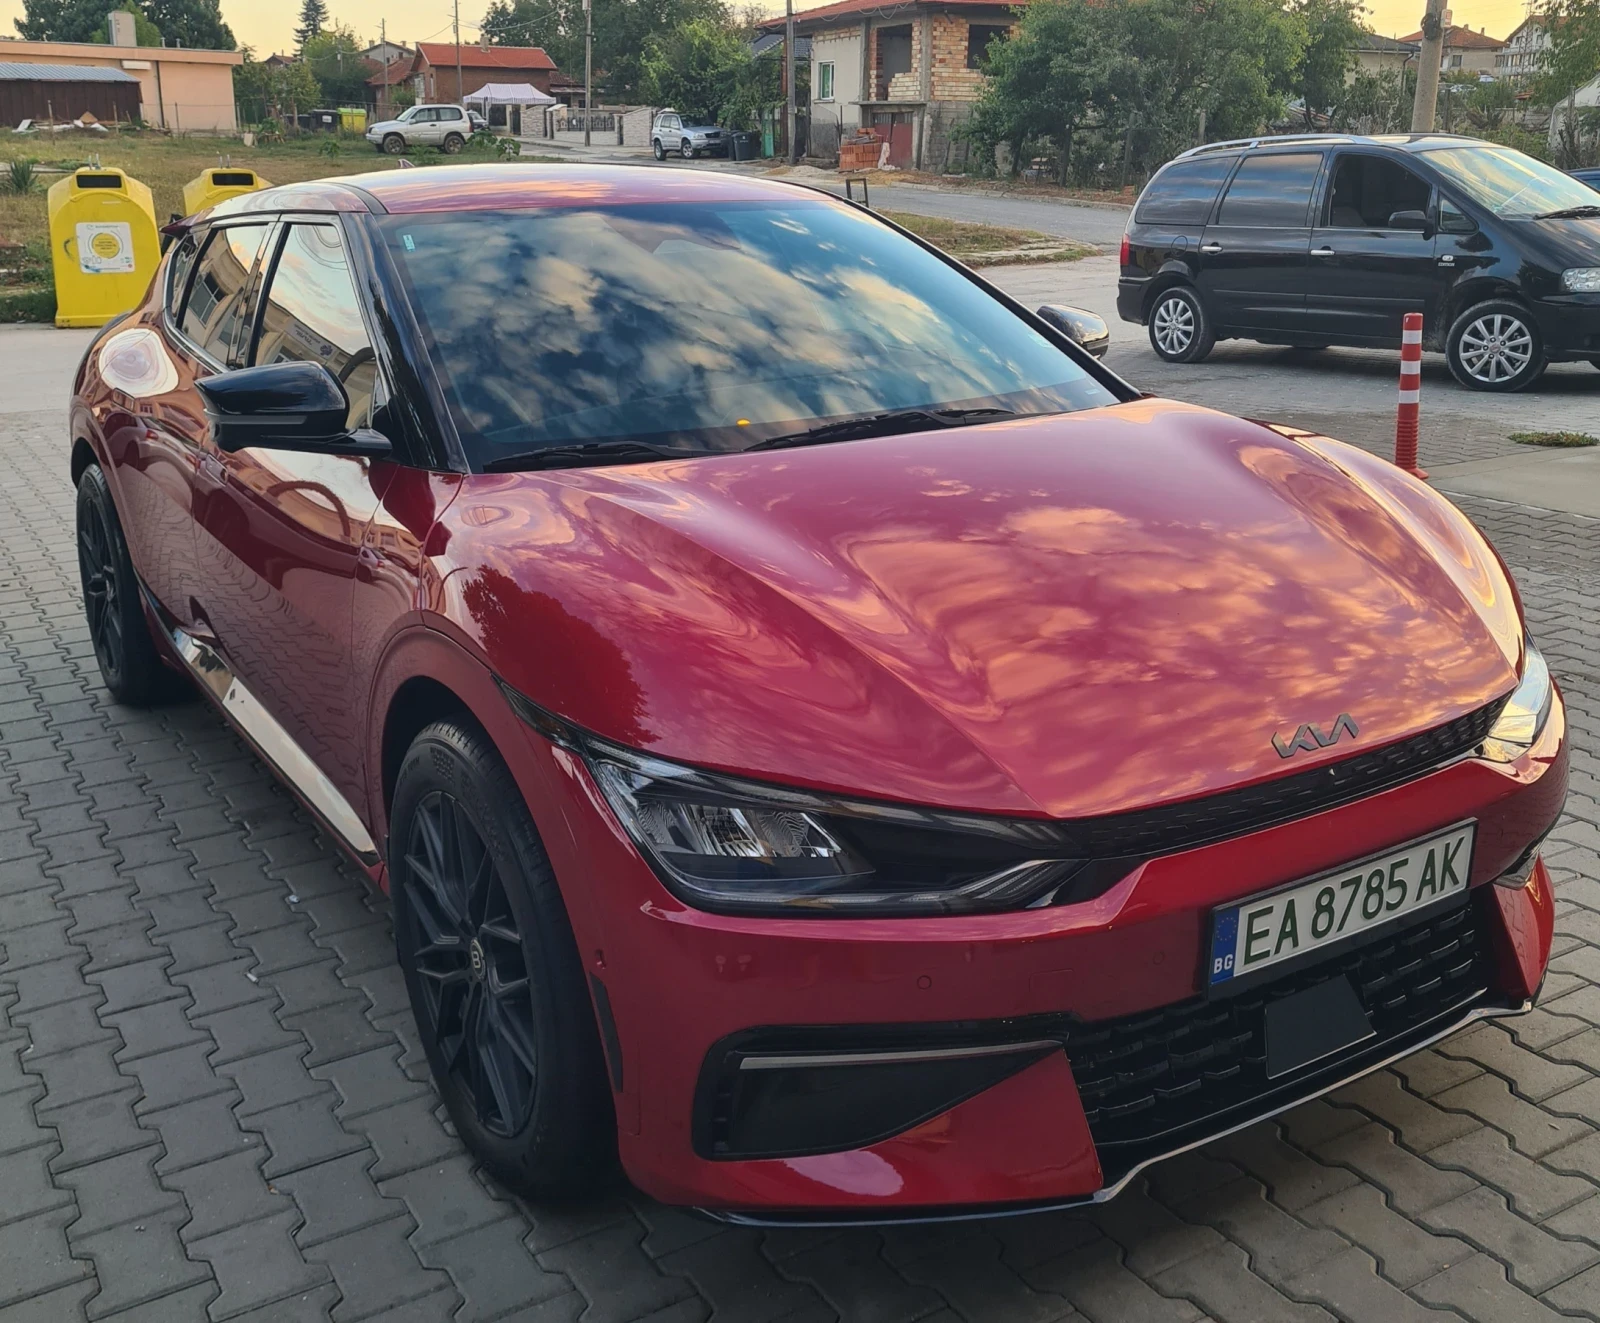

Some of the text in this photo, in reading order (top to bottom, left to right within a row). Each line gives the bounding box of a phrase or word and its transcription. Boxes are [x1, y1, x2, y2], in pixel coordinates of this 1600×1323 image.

[1271, 712, 1360, 759] KIA
[1243, 836, 1465, 966] EA 8785 AK
[1213, 953, 1233, 974] BG
